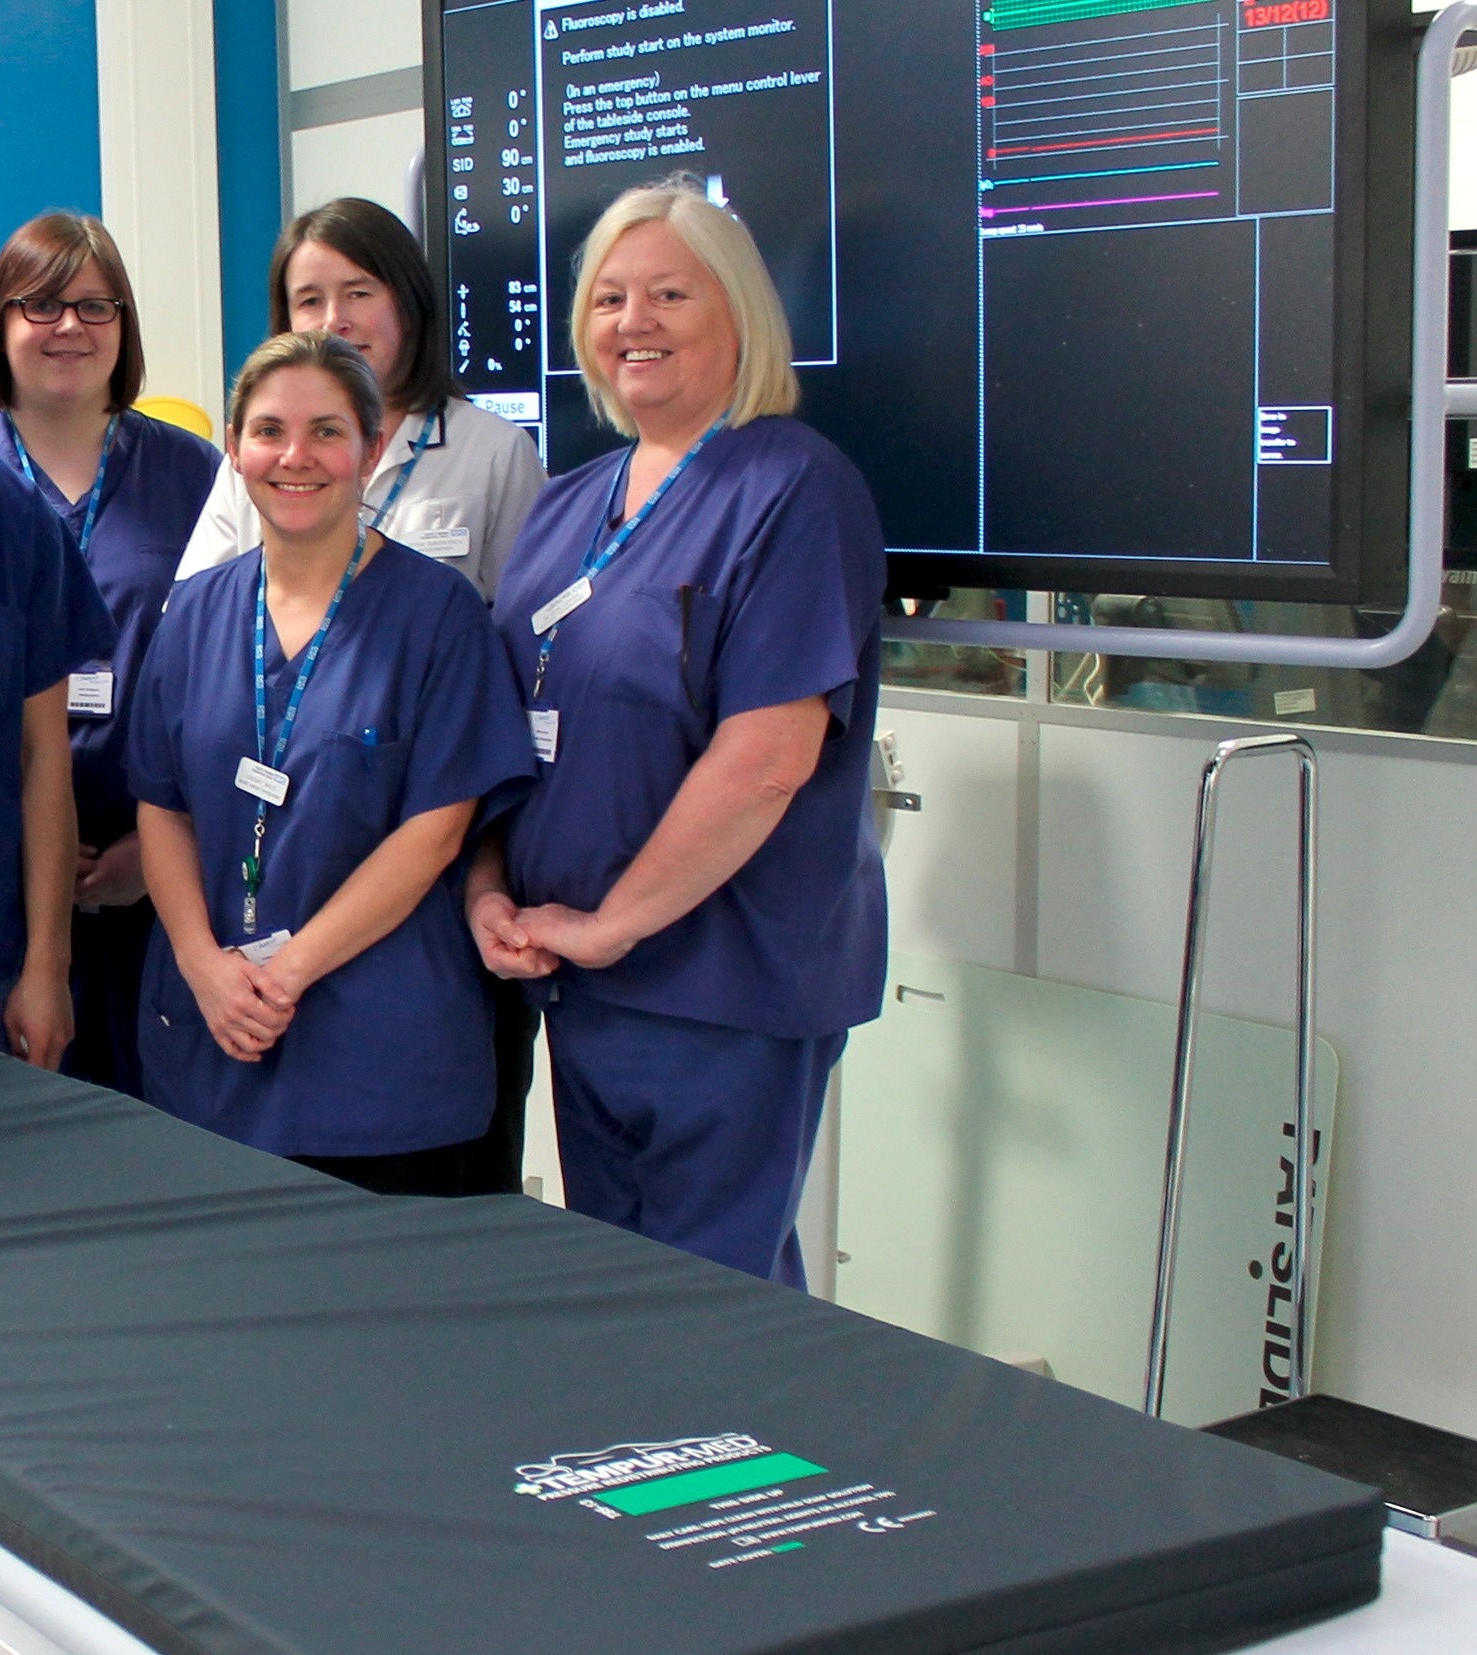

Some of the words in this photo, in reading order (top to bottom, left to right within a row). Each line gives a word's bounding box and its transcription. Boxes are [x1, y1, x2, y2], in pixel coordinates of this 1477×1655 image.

[561, 12, 624, 32] Fluoroscopy
[626, 7, 637, 21] is
[639, 0, 685, 19] disabled.
[1244, 0, 1329, 27] 13/12(12)
[562, 48, 604, 65] Perform
[606, 42, 636, 58] study
[637, 38, 664, 54] start
[666, 37, 681, 49] on
[683, 31, 702, 47] the
[704, 28, 745, 45] system
[747, 18, 796, 37] monitor.
[563, 101, 594, 116] Press
[594, 97, 613, 112] the
[615, 96, 634, 110] top
[635, 91, 672, 107] button
[673, 88, 688, 101] on
[689, 84, 710, 99] the
[711, 81, 744, 97] menu
[745, 71, 788, 92] control
[790, 70, 821, 86] lever
[582, 85, 596, 97] an
[597, 70, 660, 93] emergency)
[563, 118, 575, 133] of
[577, 117, 595, 131] the
[596, 110, 644, 129] tableside
[646, 104, 692, 122] console.
[564, 132, 622, 149] Emergency
[623, 125, 653, 142] study
[655, 123, 689, 139] starts
[452, 157, 474, 173] SID
[501, 148, 520, 168] 90
[564, 151, 584, 167] and
[585, 146, 646, 164] fluoroscopy
[647, 143, 658, 157] is
[660, 137, 706, 155] enabled.
[502, 176, 521, 196] 30
[485, 400, 525, 414] Pause
[1259, 1121, 1321, 1410] PATSLID
[533, 1436, 758, 1490] TEMPUR-MED
